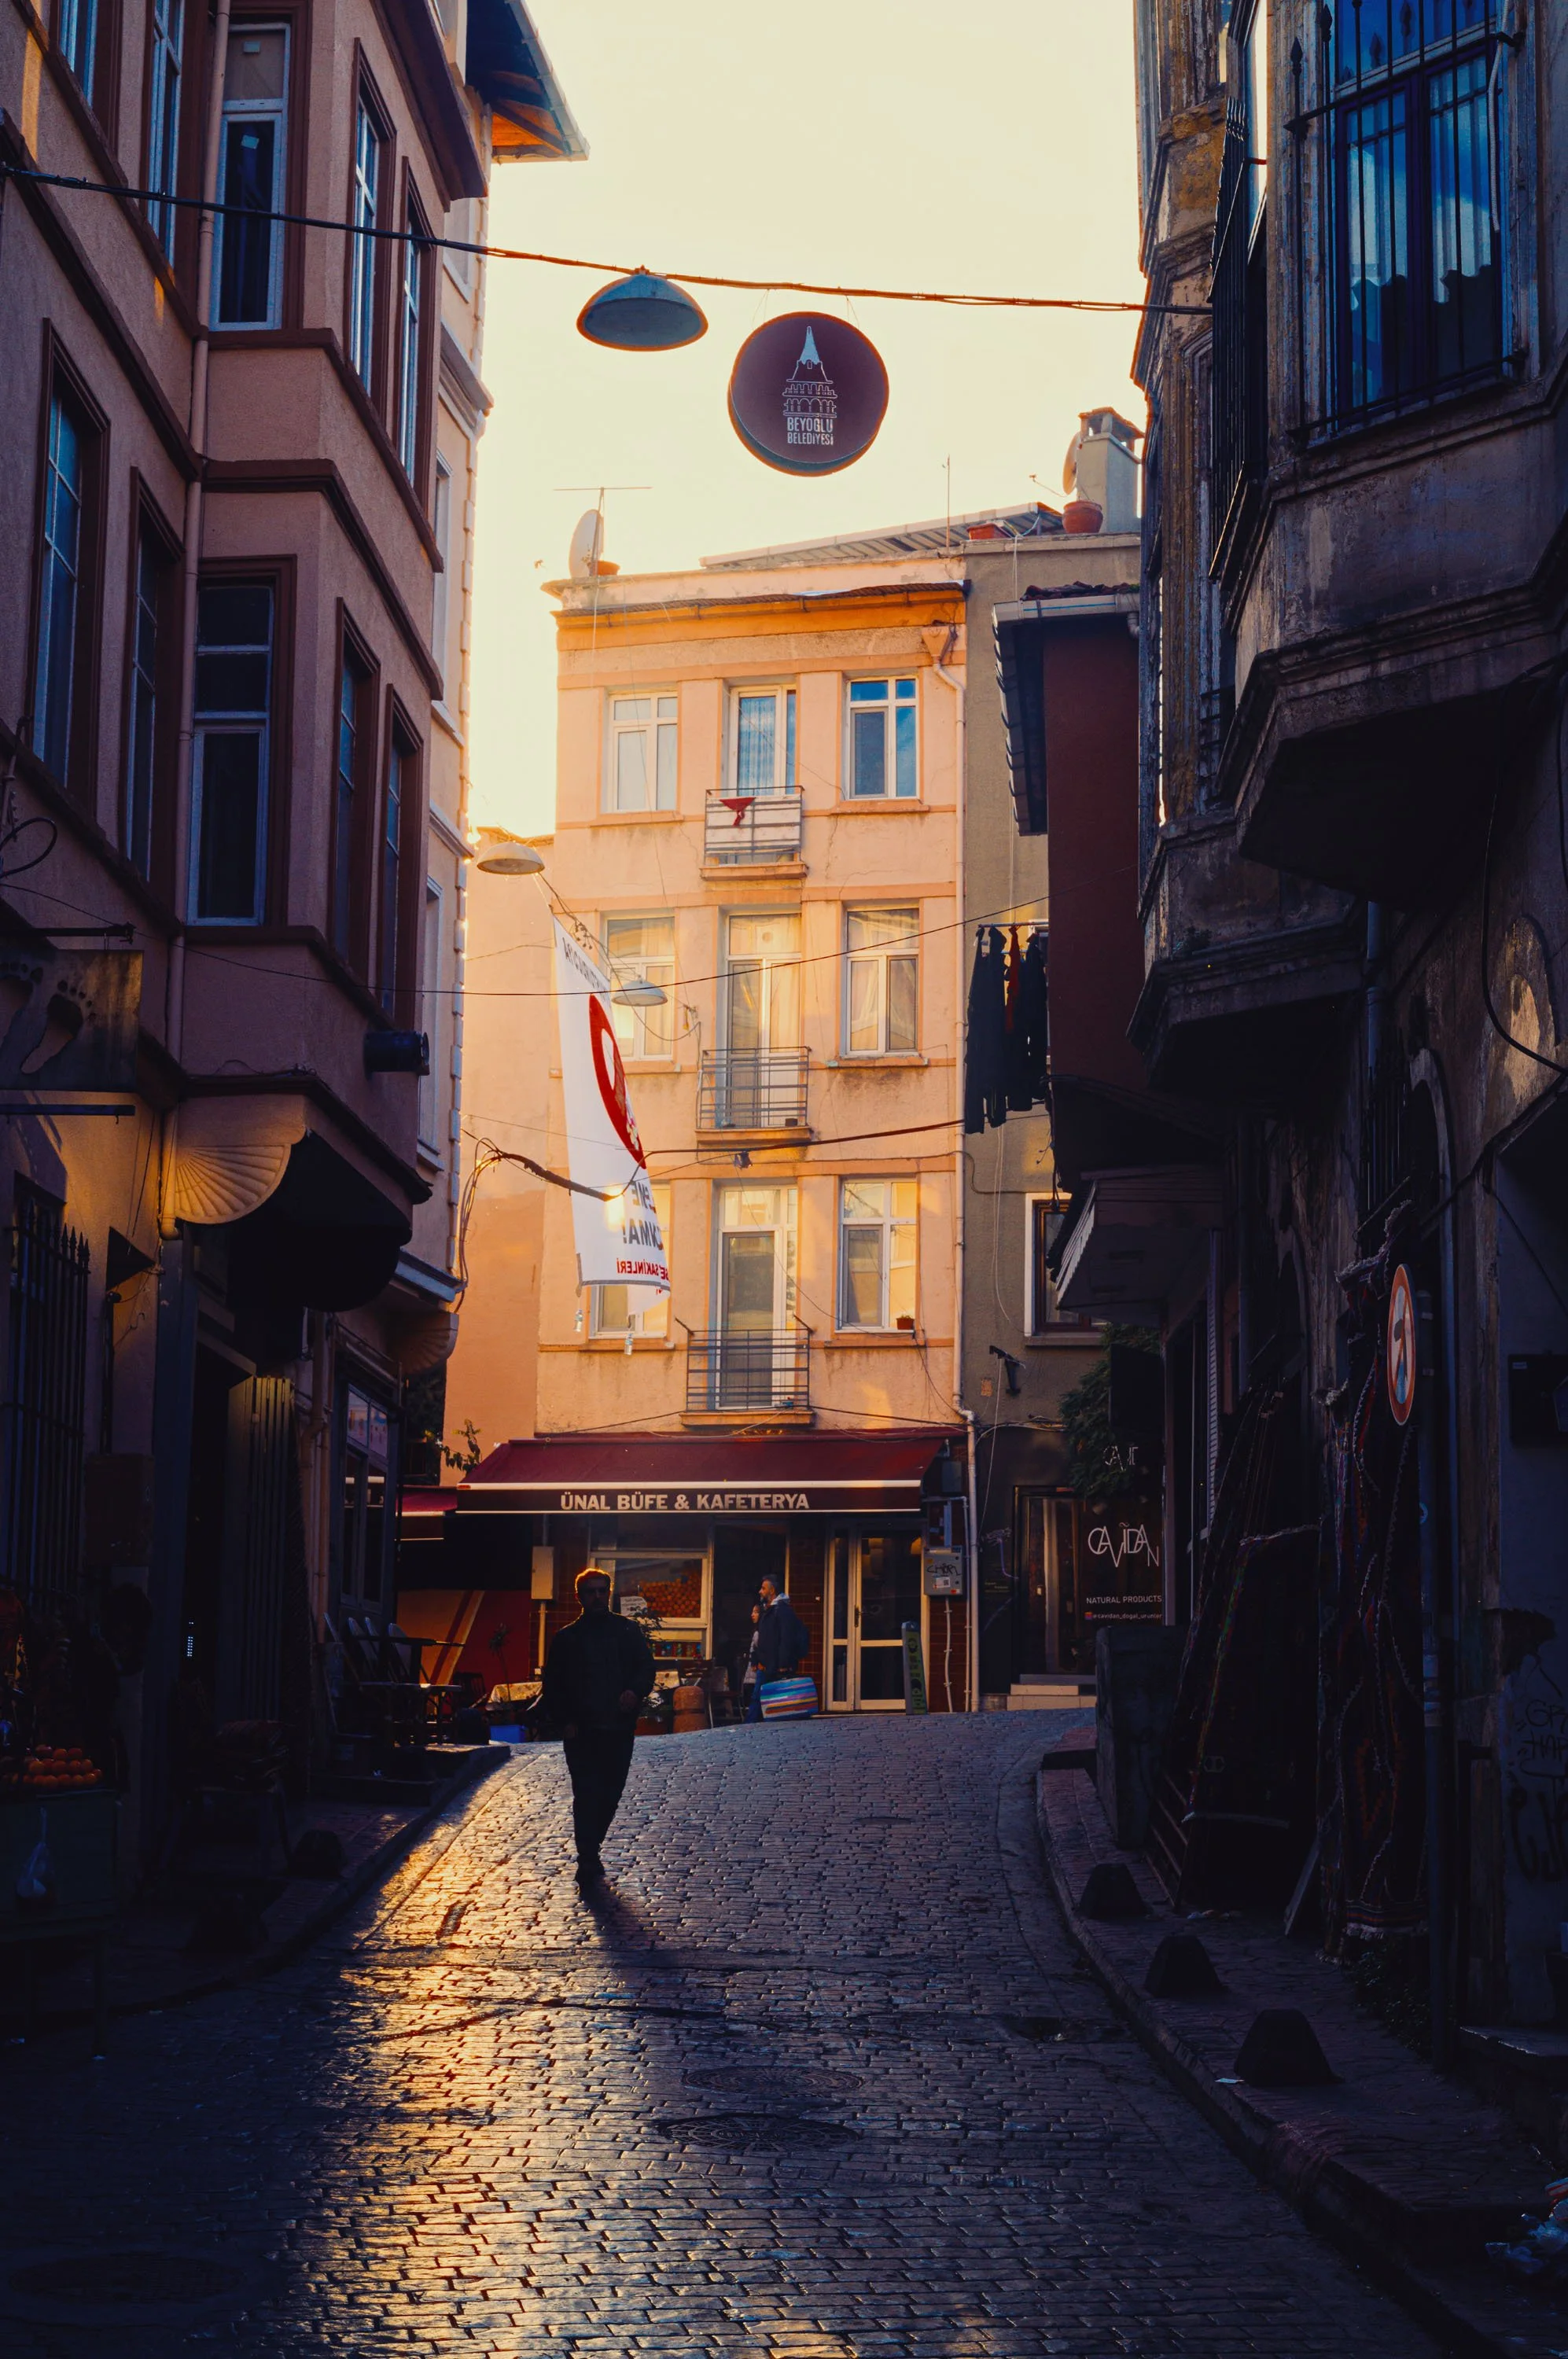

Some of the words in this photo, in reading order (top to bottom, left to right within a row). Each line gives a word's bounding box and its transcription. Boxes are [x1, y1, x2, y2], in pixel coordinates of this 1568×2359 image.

[787, 432, 834, 446] BELEDİYESİ
[560, 1491, 611, 1511] ÜNAL
[617, 1491, 668, 1511] BÜFE
[675, 1494, 690, 1511] &
[697, 1493, 810, 1510] KAFETERYA
[1086, 1596, 1121, 1605] NATURAL
[1123, 1595, 1163, 1603] PRODUCTS
